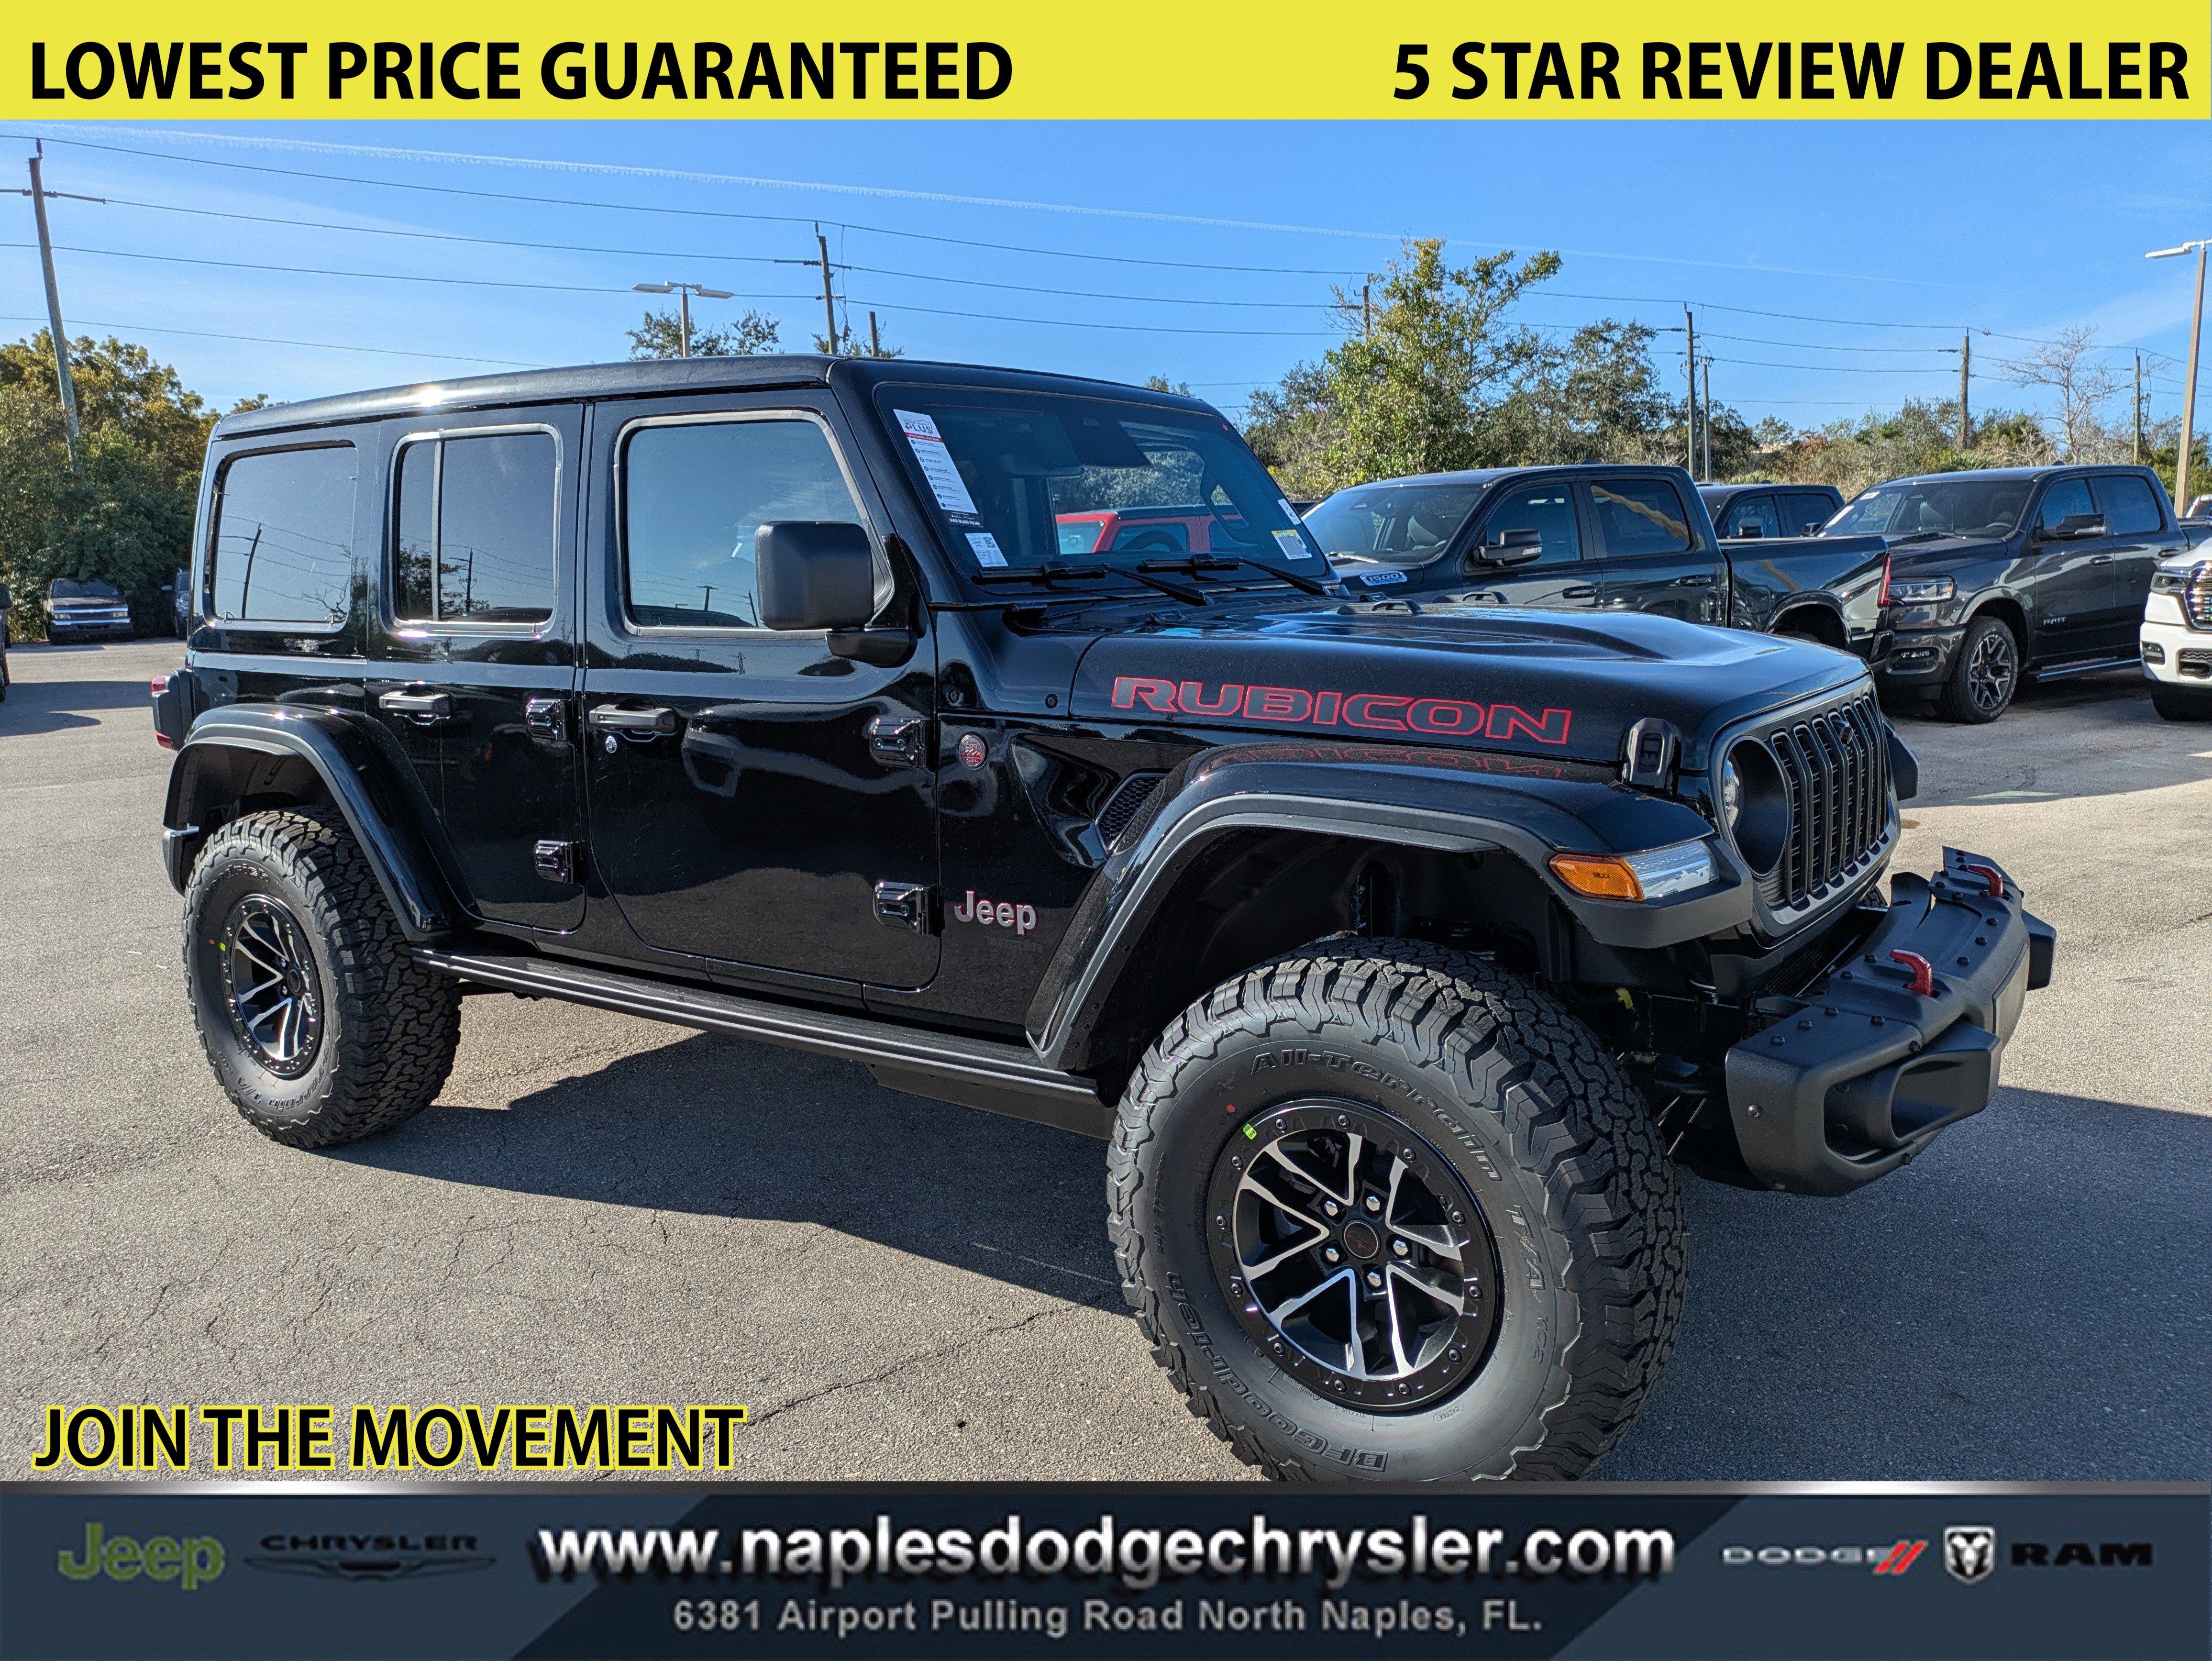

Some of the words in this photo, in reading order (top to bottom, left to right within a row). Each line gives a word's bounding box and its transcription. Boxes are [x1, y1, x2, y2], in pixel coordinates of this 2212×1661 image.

[905, 422, 932, 433] PLUS
[1367, 573, 1399, 582] 1500
[1111, 676, 1572, 745] RUBICON
[953, 890, 1039, 936] Jeep
[1250, 1047, 1503, 1183] All-Terrain
[1512, 1202, 1548, 1292] T/A
[1165, 1272, 1388, 1473] BFGoodrich
